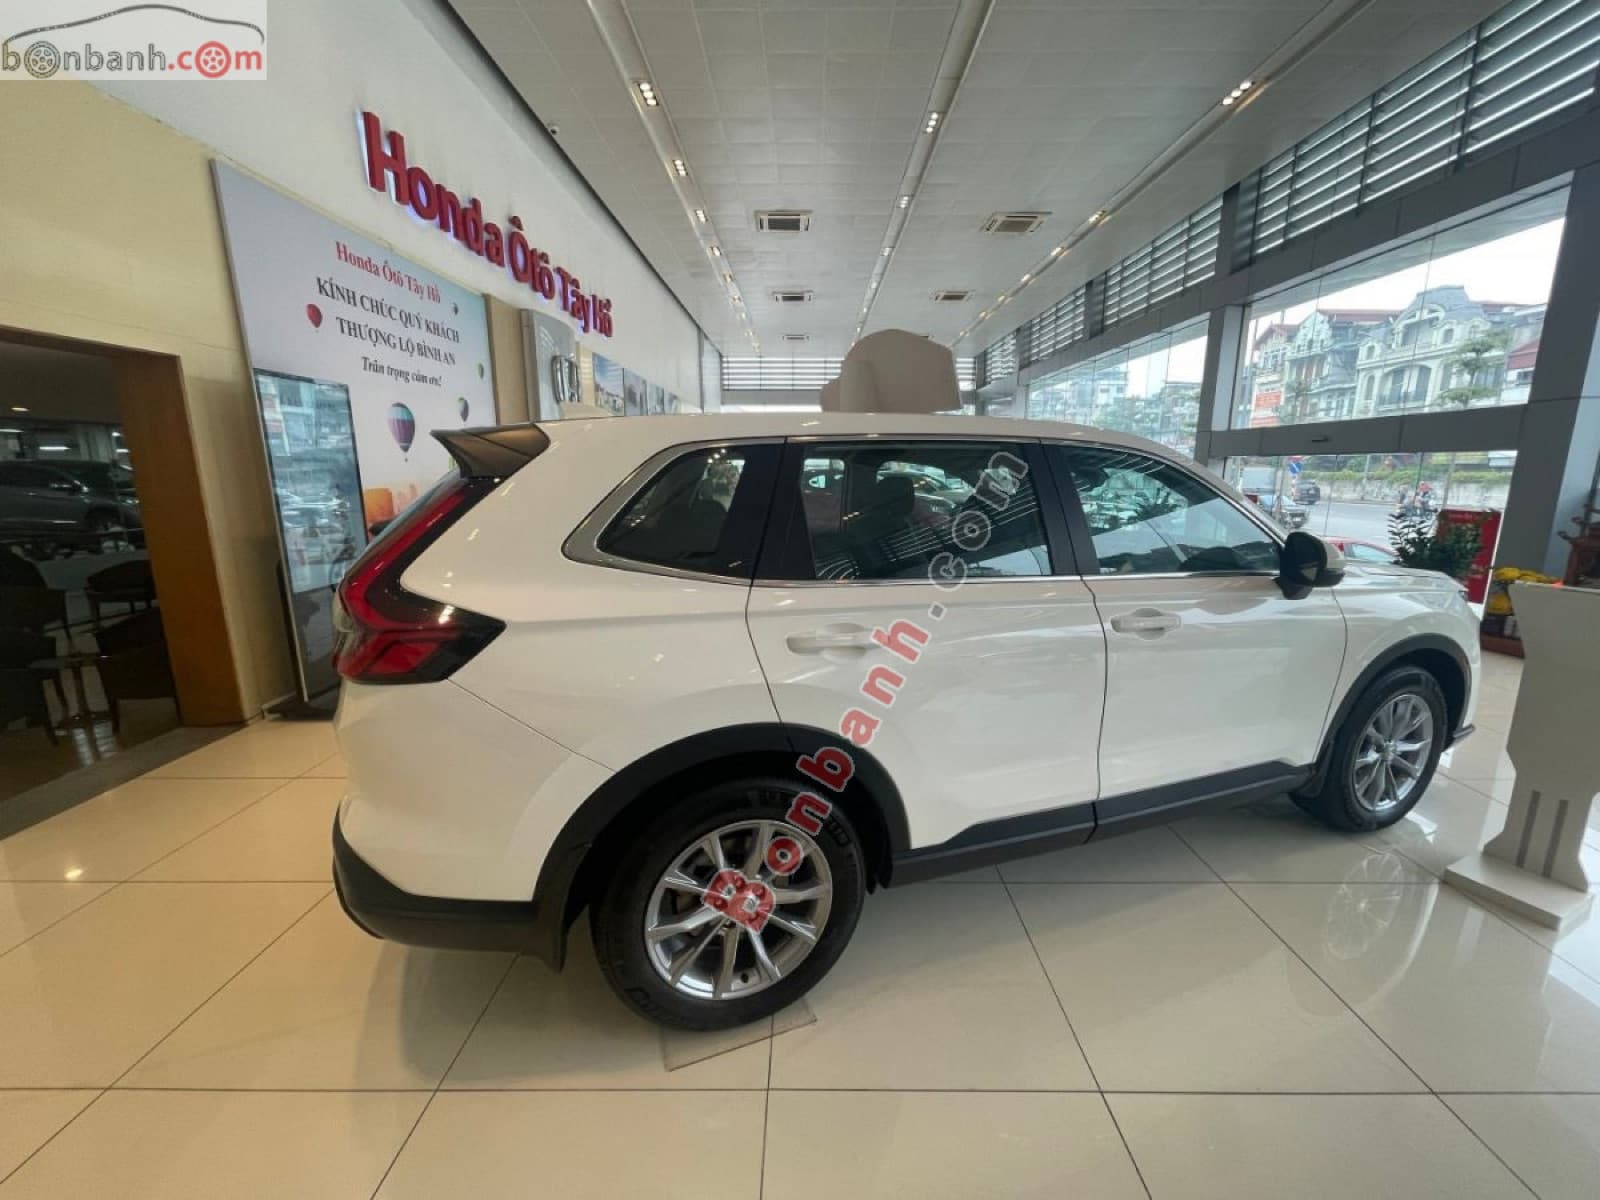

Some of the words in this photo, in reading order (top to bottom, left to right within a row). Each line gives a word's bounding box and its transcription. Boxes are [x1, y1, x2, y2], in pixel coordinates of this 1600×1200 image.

[362, 111, 505, 268] Honda
[508, 215, 555, 300] Ôtô
[555, 266, 590, 334] Tây
[335, 241, 380, 277] Honda
[405, 274, 425, 299] Tây
[316, 276, 357, 307] KÍNH
[360, 294, 397, 321] CHÚC
[400, 309, 423, 329] QUÝ
[424, 319, 460, 343] KHÁCH
[336, 316, 397, 349] THƯỢNG
